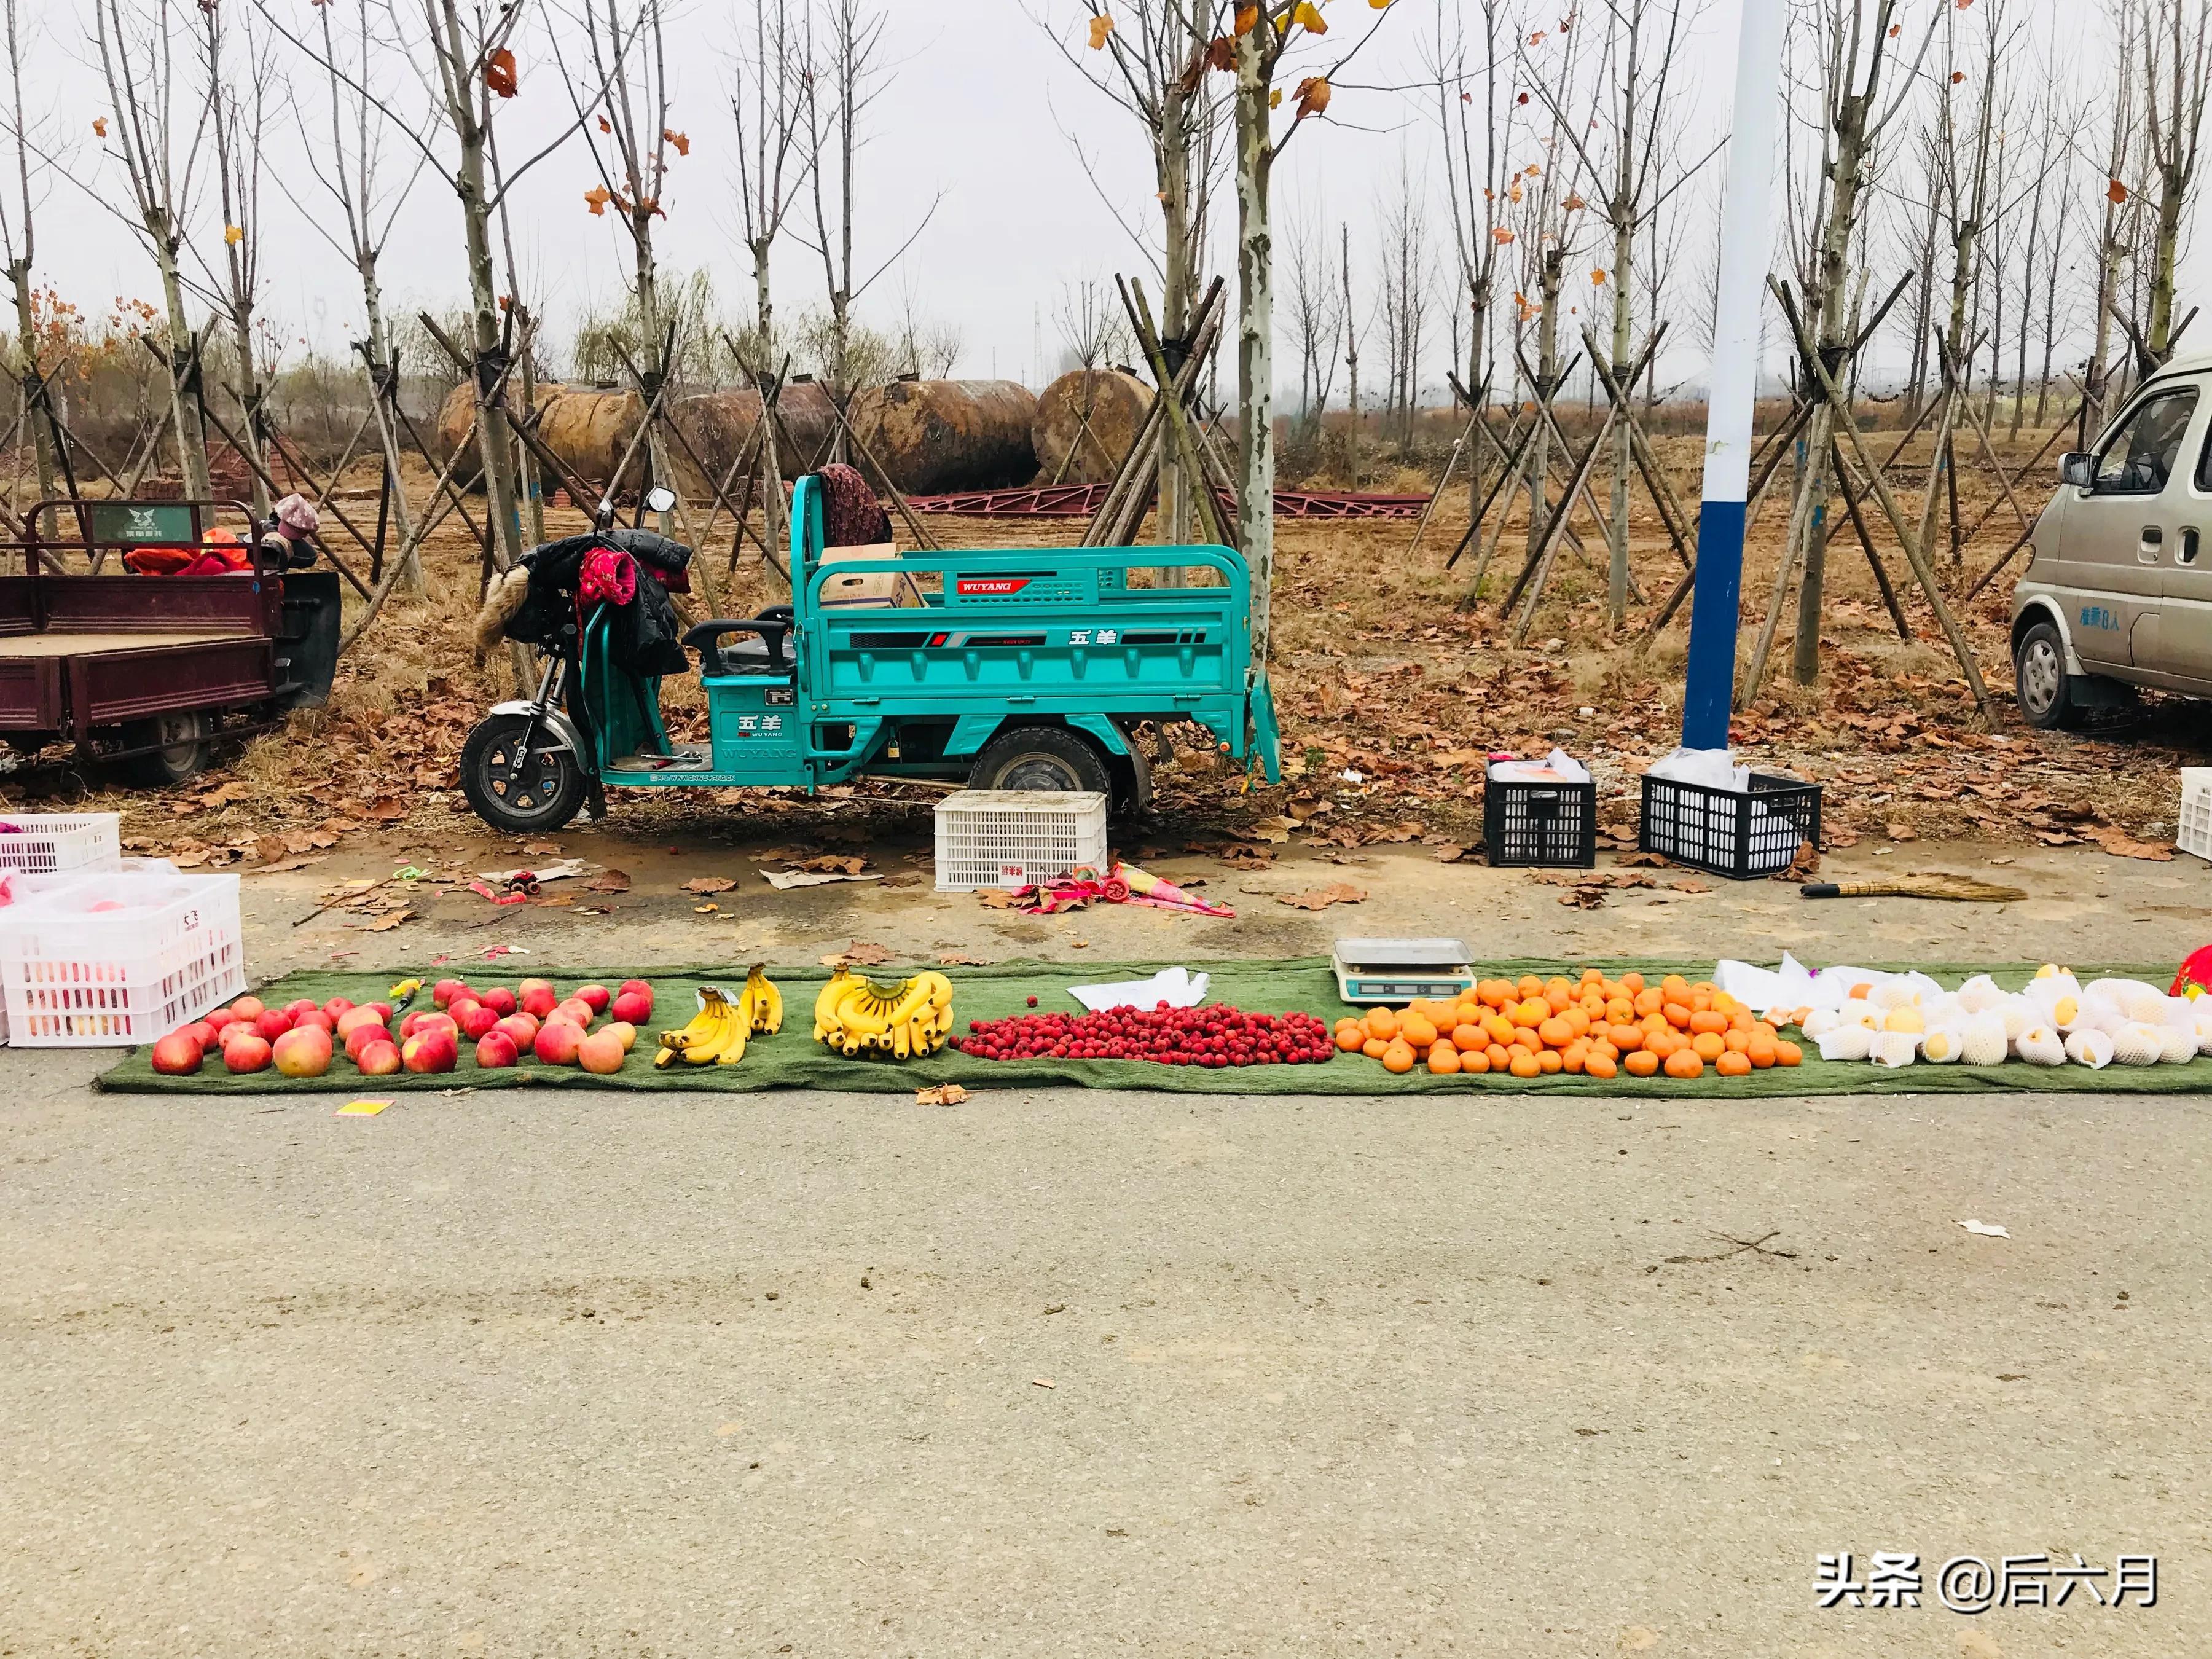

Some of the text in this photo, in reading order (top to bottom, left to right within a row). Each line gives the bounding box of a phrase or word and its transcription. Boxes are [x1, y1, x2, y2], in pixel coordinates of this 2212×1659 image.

[1069, 629, 1117, 645] 五羊
[738, 715, 782, 730] 五羊
[721, 748, 797, 759] WUYANG
